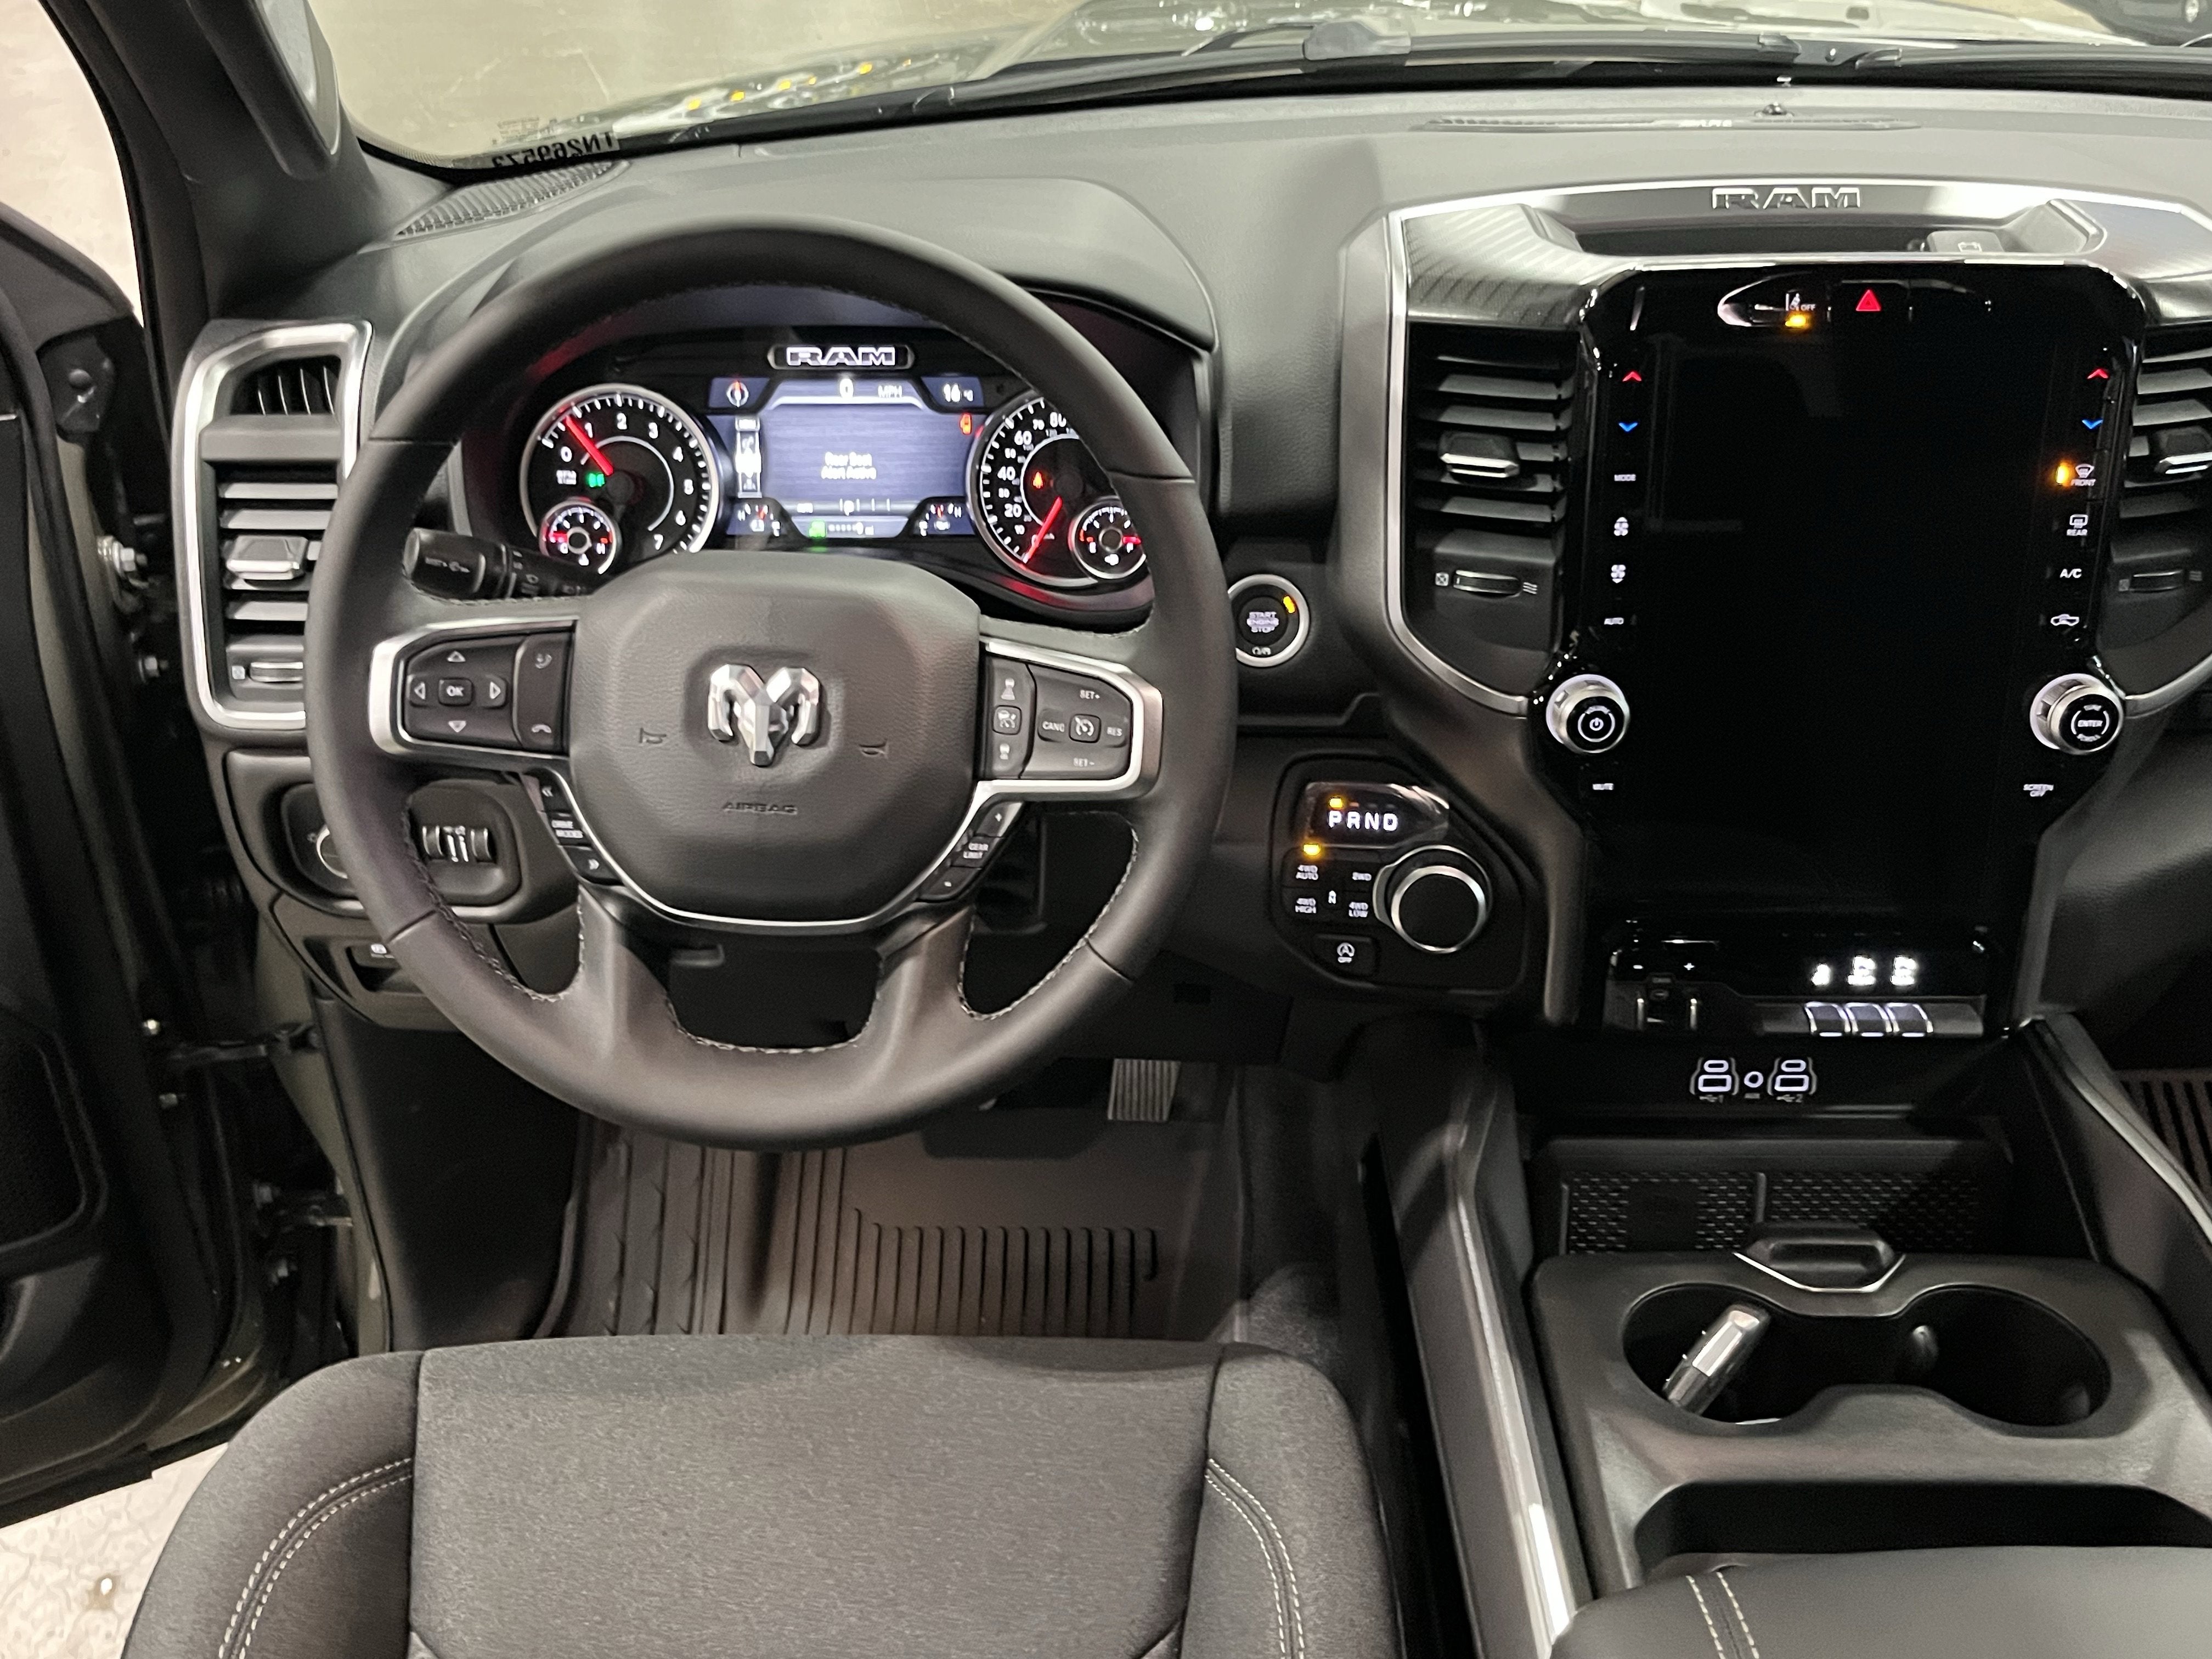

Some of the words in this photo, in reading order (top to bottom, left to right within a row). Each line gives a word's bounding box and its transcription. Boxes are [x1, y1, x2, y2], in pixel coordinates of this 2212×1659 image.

[1711, 187, 1861, 209] RAM
[786, 346, 895, 366] RAM
[617, 413, 627, 430] 2
[584, 422, 593, 438] 1
[648, 422, 658, 439] 3
[1014, 430, 1032, 445] 60
[560, 446, 572, 462] 0
[673, 446, 684, 462] 4
[997, 466, 1016, 481] 40
[675, 510, 686, 526] 6
[1004, 503, 1022, 518] 20
[653, 534, 664, 550] 7
[2059, 568, 2082, 579] A/C
[445, 685, 465, 698] OK
[722, 802, 798, 814] AIRBAG
